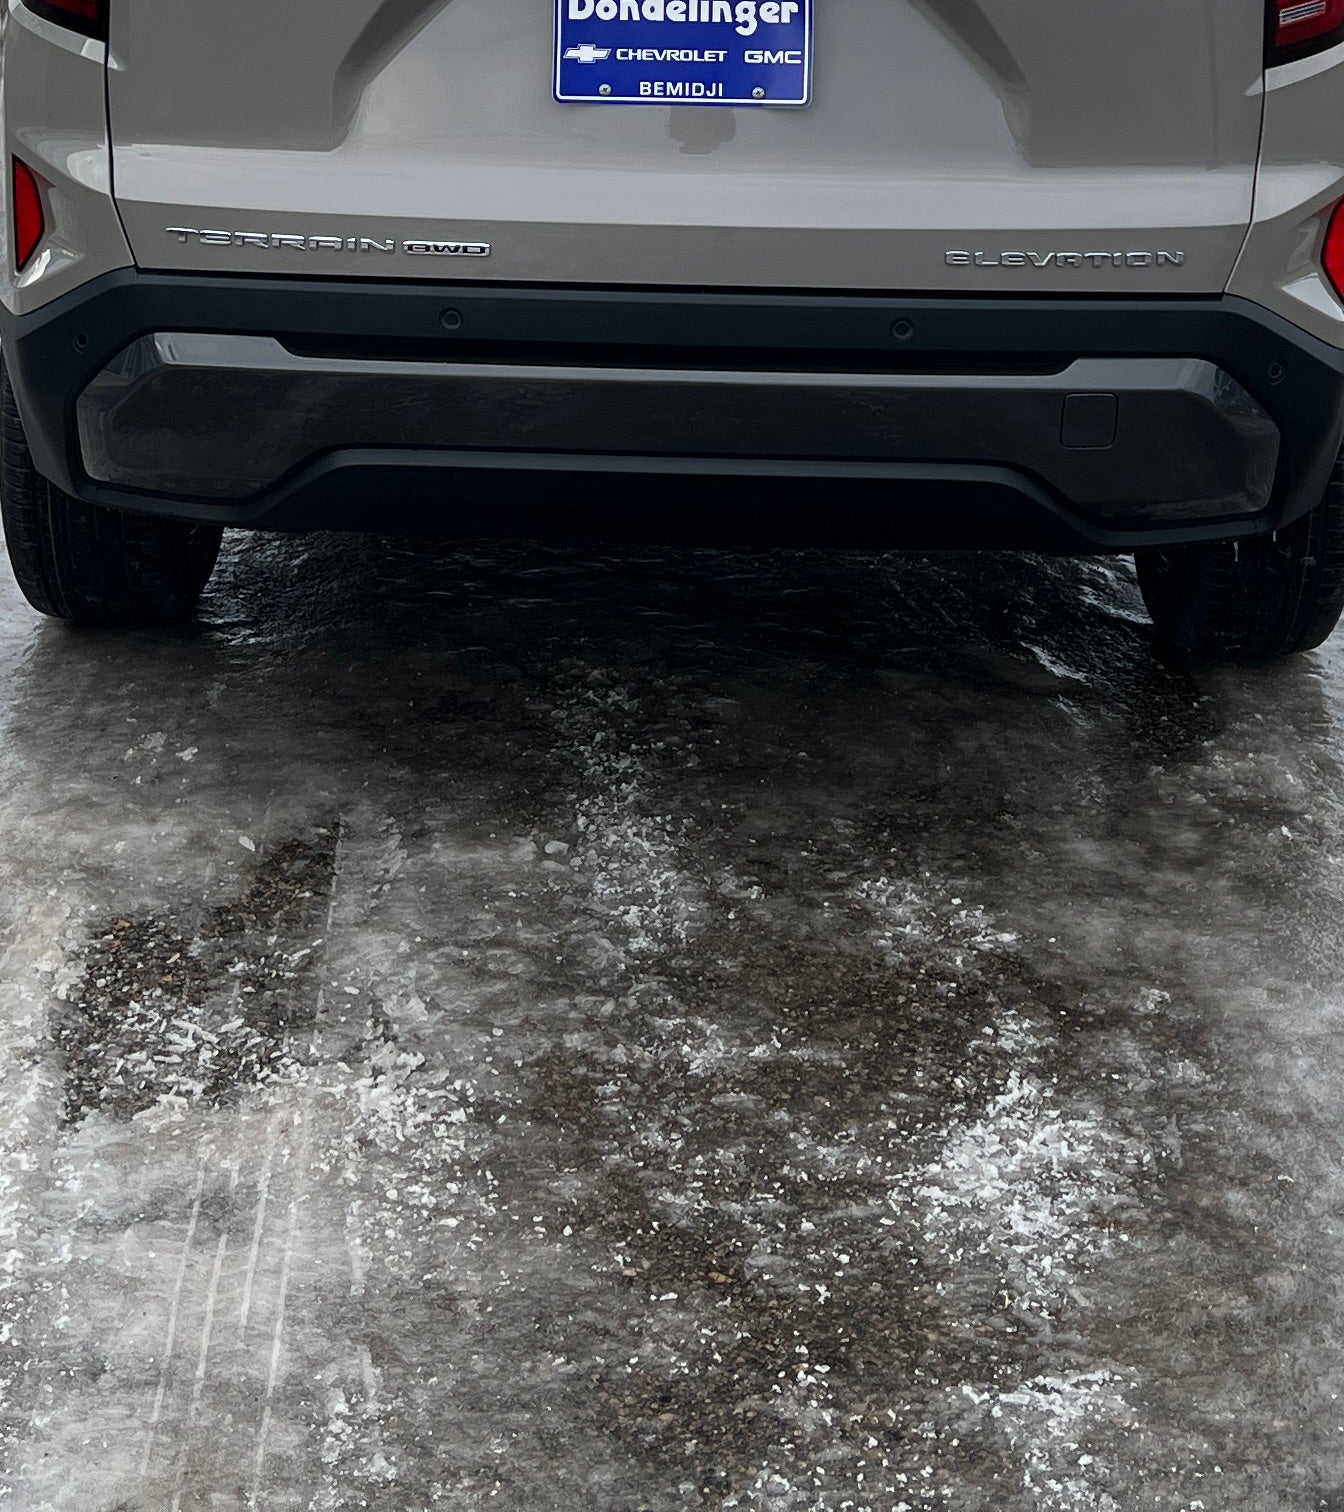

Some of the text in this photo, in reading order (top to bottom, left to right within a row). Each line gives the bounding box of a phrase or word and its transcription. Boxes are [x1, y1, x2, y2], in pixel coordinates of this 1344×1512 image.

[616, 48, 802, 64] CHEVROLET GMC
[639, 81, 723, 97] BEMIDJI
[165, 227, 491, 256] TERRAIN AWD
[945, 250, 1185, 267] ELEVATION
